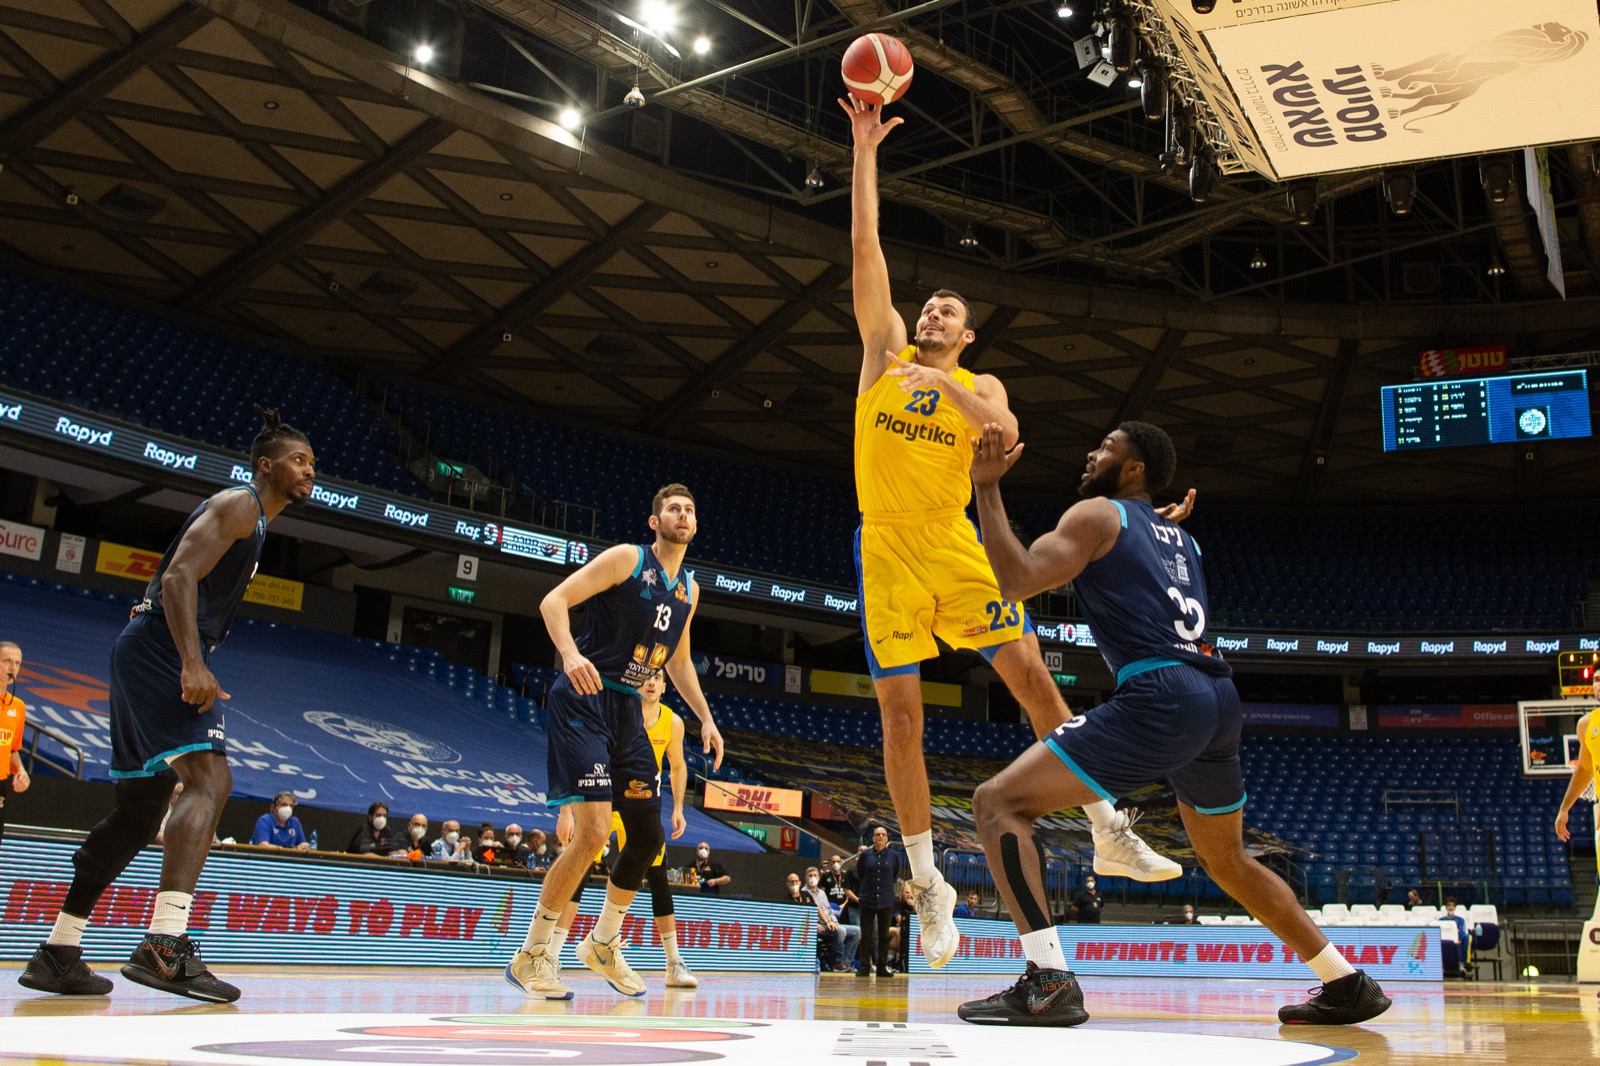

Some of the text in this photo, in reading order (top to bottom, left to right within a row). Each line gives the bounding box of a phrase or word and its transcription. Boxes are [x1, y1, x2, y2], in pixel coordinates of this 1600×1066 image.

[1236, 4, 1274, 18] בדרכים
[1260, 60, 1338, 147] שאשא
[1322, 65, 1387, 142] מסיעי
[904, 389, 941, 416] 23
[55, 417, 113, 446] Rapyd
[875, 411, 956, 448] Playtika
[143, 442, 197, 470] Rapyd
[310, 485, 359, 509] Rapyd
[384, 504, 429, 527] Rapyd
[568, 541, 589, 565] 10
[463, 560, 473, 575] 9
[715, 575, 752, 593] Rapyd
[771, 584, 805, 602] Rapyd
[825, 594, 857, 612] Rapyd
[653, 603, 672, 632] 13
[986, 601, 1020, 631] 23
[1057, 624, 1076, 643] 10
[1216, 637, 1248, 651] Rapyd
[1266, 638, 1298, 652] Rapyd
[1317, 640, 1349, 654] Rapyd
[1367, 641, 1400, 655] Rapyd
[1421, 641, 1454, 655] Rapyd
[1473, 640, 1507, 654] Rapyd
[1526, 639, 1560, 654] Rapyd
[715, 656, 766, 683] טריפל
[1047, 656, 1060, 668] 10
[383, 760, 534, 786] MACCABI
[392, 774, 549, 806] Playtik
[736, 788, 773, 811] DHL
[226, 893, 339, 933] WAYS
[347, 898, 395, 937] TO
[400, 904, 484, 939] PLAY
[718, 921, 743, 949] TO
[747, 924, 793, 950] PLAY
[974, 936, 1006, 959] WAYS
[1074, 941, 1188, 962] INFINITE
[1196, 942, 1274, 963] WAYS
